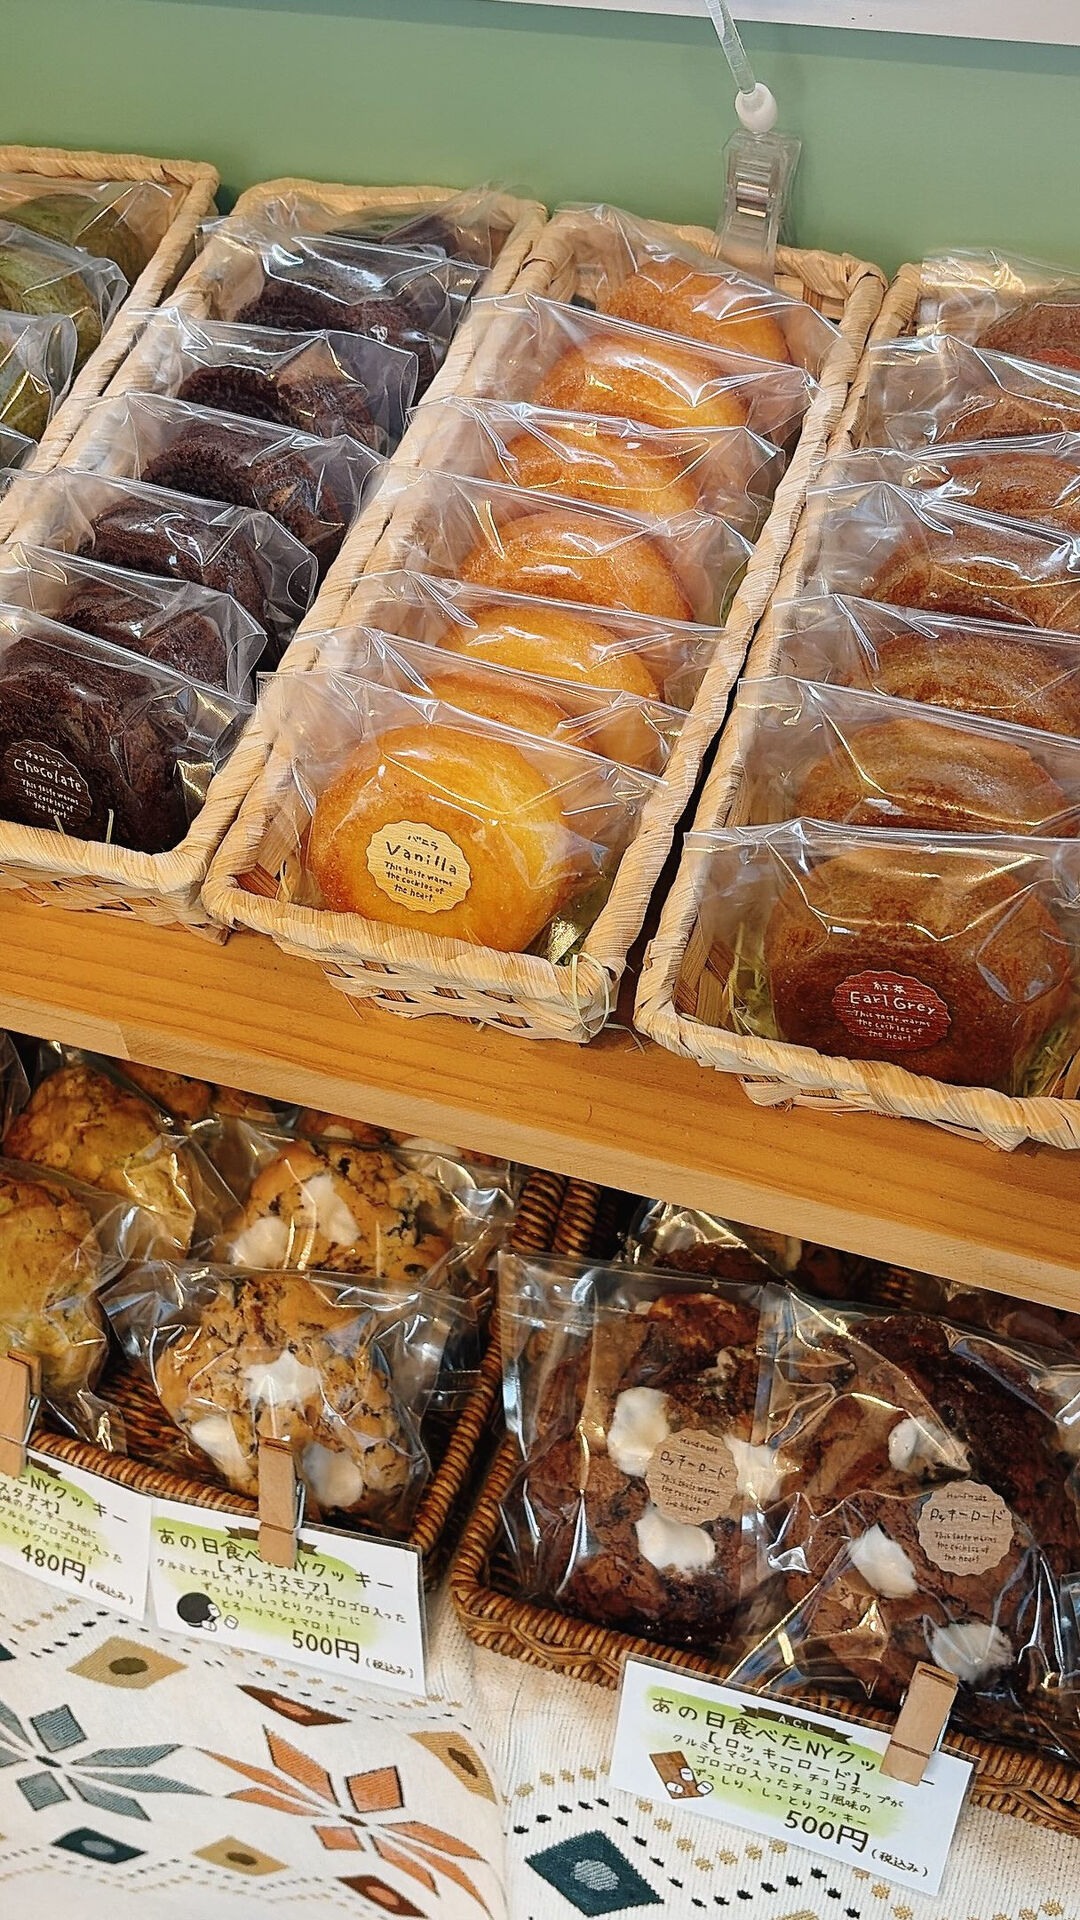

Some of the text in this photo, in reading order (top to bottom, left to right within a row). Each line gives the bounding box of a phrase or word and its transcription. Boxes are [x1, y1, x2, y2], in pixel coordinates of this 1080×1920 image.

[14, 759, 81, 792] Chocolate
[386, 841, 457, 875] Vanilla
[408, 835, 438, 851] バニラ
[384, 861, 453, 887] This taste warms
[386, 871, 445, 895] the cockles of
[394, 883, 407, 894] the
[850, 991, 936, 1015] Earl Grey
[854, 1010, 873, 1018] This
[930, 1508, 1006, 1525] ロッキーロード
[21, 1543, 86, 1583] 480円
[157, 1528, 394, 1590] あの日食べYクッキー
[217, 1559, 329, 1596] 【オレオスモア】
[292, 1629, 360, 1664] 500円
[652, 1697, 935, 1786] あの日食べたNYクッー
[708, 1730, 861, 1786] 【ロッキーロード】
[672, 1733, 904, 1808] クルミとマシュマロ、チョコチップが
[696, 1754, 872, 1815] ゴロゴロ入ったチョコ風味の
[693, 1767, 867, 1826] ずっしり、しっとりクッキー
[784, 1809, 869, 1853] 500円
